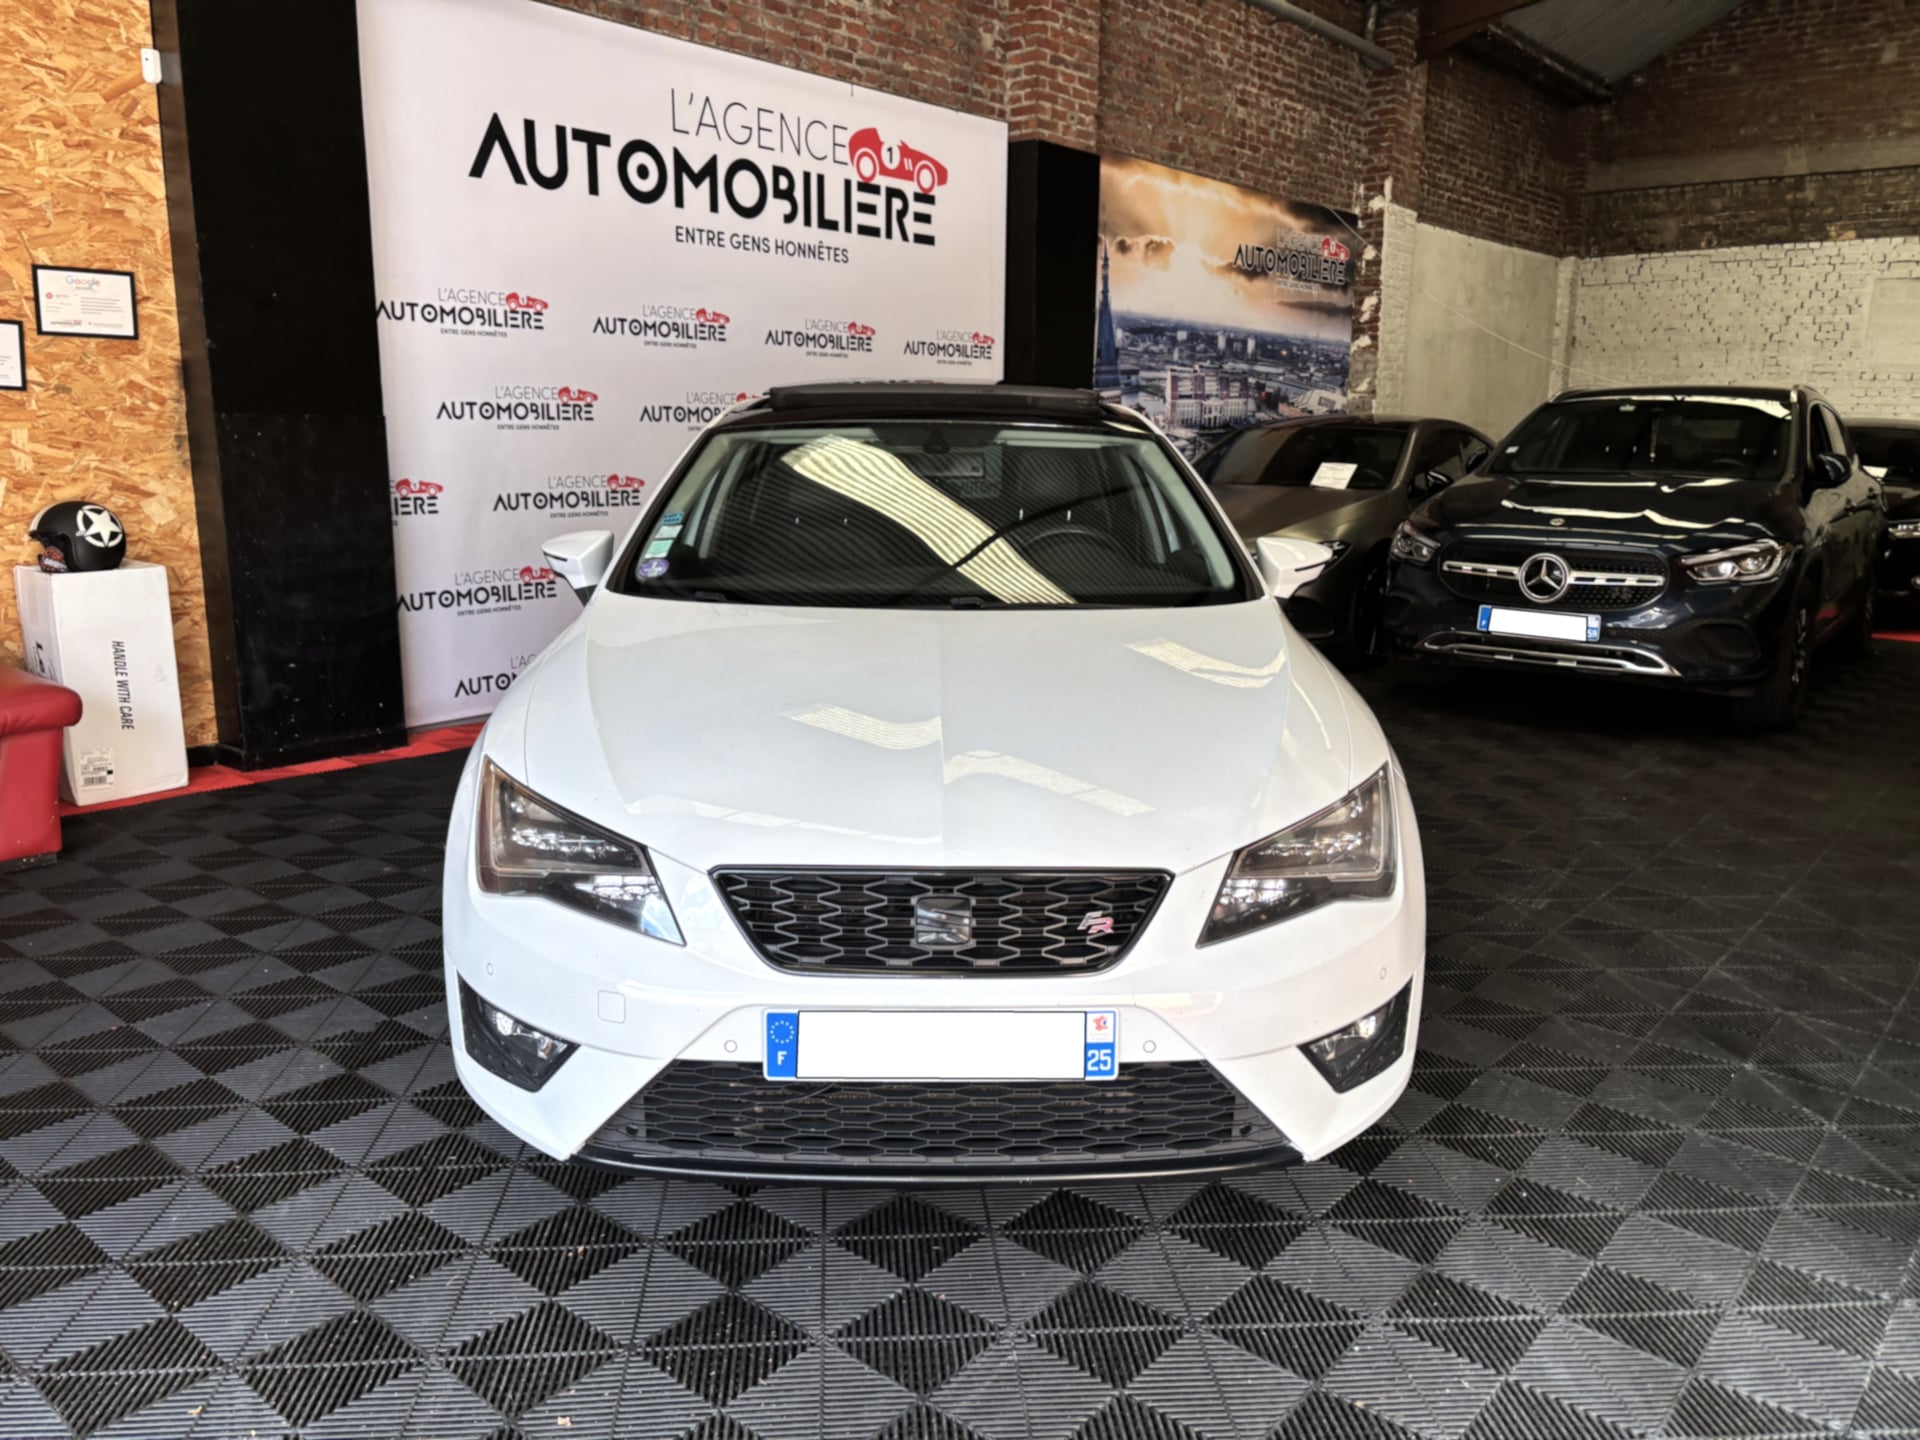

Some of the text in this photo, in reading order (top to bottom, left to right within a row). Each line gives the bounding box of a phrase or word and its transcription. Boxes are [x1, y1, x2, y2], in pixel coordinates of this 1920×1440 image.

[671, 88, 848, 166] L'AGENCE
[675, 225, 849, 264] ENTRE GENS HONNÊTES
[65, 274, 101, 289] Google
[437, 287, 506, 307] L'AGENCE
[642, 304, 696, 321] L'AGENCE
[494, 385, 559, 401] L'AGENCE
[547, 475, 607, 490] L'AGENCE
[454, 567, 520, 586] L'AGENCE
[112, 640, 135, 730] HANDLE WITH CARE
[1077, 910, 1114, 934] FR
[776, 1048, 1112, 1071] F 25
